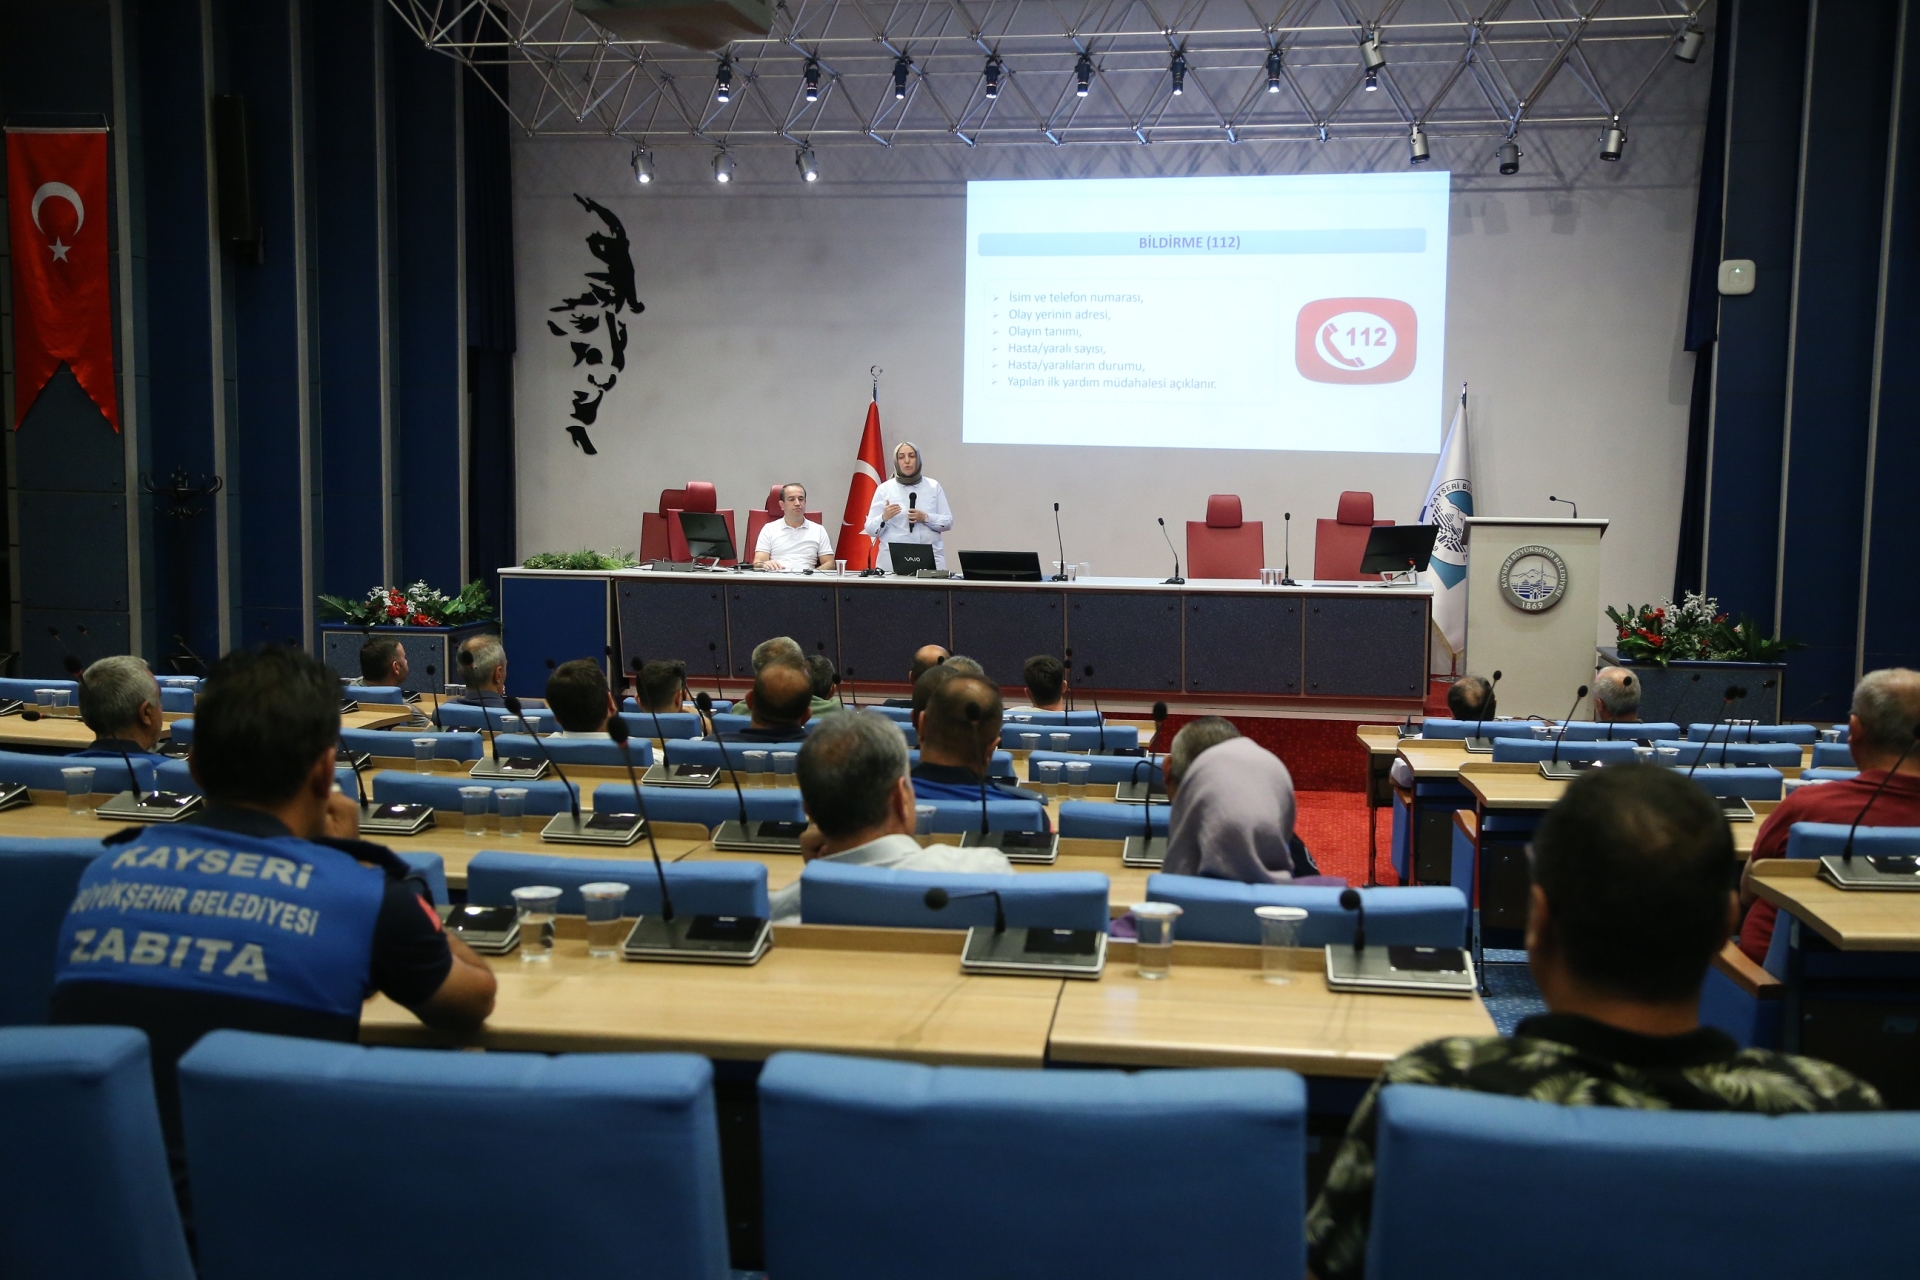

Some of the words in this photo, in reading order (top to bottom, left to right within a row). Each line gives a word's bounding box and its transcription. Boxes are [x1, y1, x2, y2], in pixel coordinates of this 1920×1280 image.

[1139, 234, 1203, 249] BİLDİRME
[1207, 235, 1241, 250] (112)
[1009, 290, 1031, 303] İsim
[1034, 294, 1047, 303] ve
[1050, 291, 1087, 303] telefon
[1090, 293, 1144, 304] numarası,
[1008, 308, 1032, 321] Olay
[1035, 309, 1072, 321] yerinin
[1075, 309, 1111, 321] adresi,
[1008, 325, 1042, 338] Olayın
[1045, 326, 1082, 338] tanımı,
[1346, 327, 1387, 347] 112
[1008, 342, 1071, 355] Hasta/yaralı
[1074, 344, 1106, 356] sayısı,
[1008, 359, 1095, 372] Hasta/yaralıların
[1098, 360, 1145, 373] durumu,
[1007, 376, 1045, 388] Yapılan
[1048, 376, 1060, 387] ilk
[1063, 377, 1100, 389] yardım
[1103, 377, 1167, 389] müdahalesi
[1169, 378, 1217, 391] açıklanır.
[1429, 481, 1460, 509] KAYSERİ
[1522, 601, 1543, 609] 1869
[111, 845, 314, 889] KAYSERİ
[70, 878, 188, 915] BÜYÜKŞEHİR
[187, 888, 320, 937] BELEDİYESİ
[69, 927, 269, 983] ZABITA
